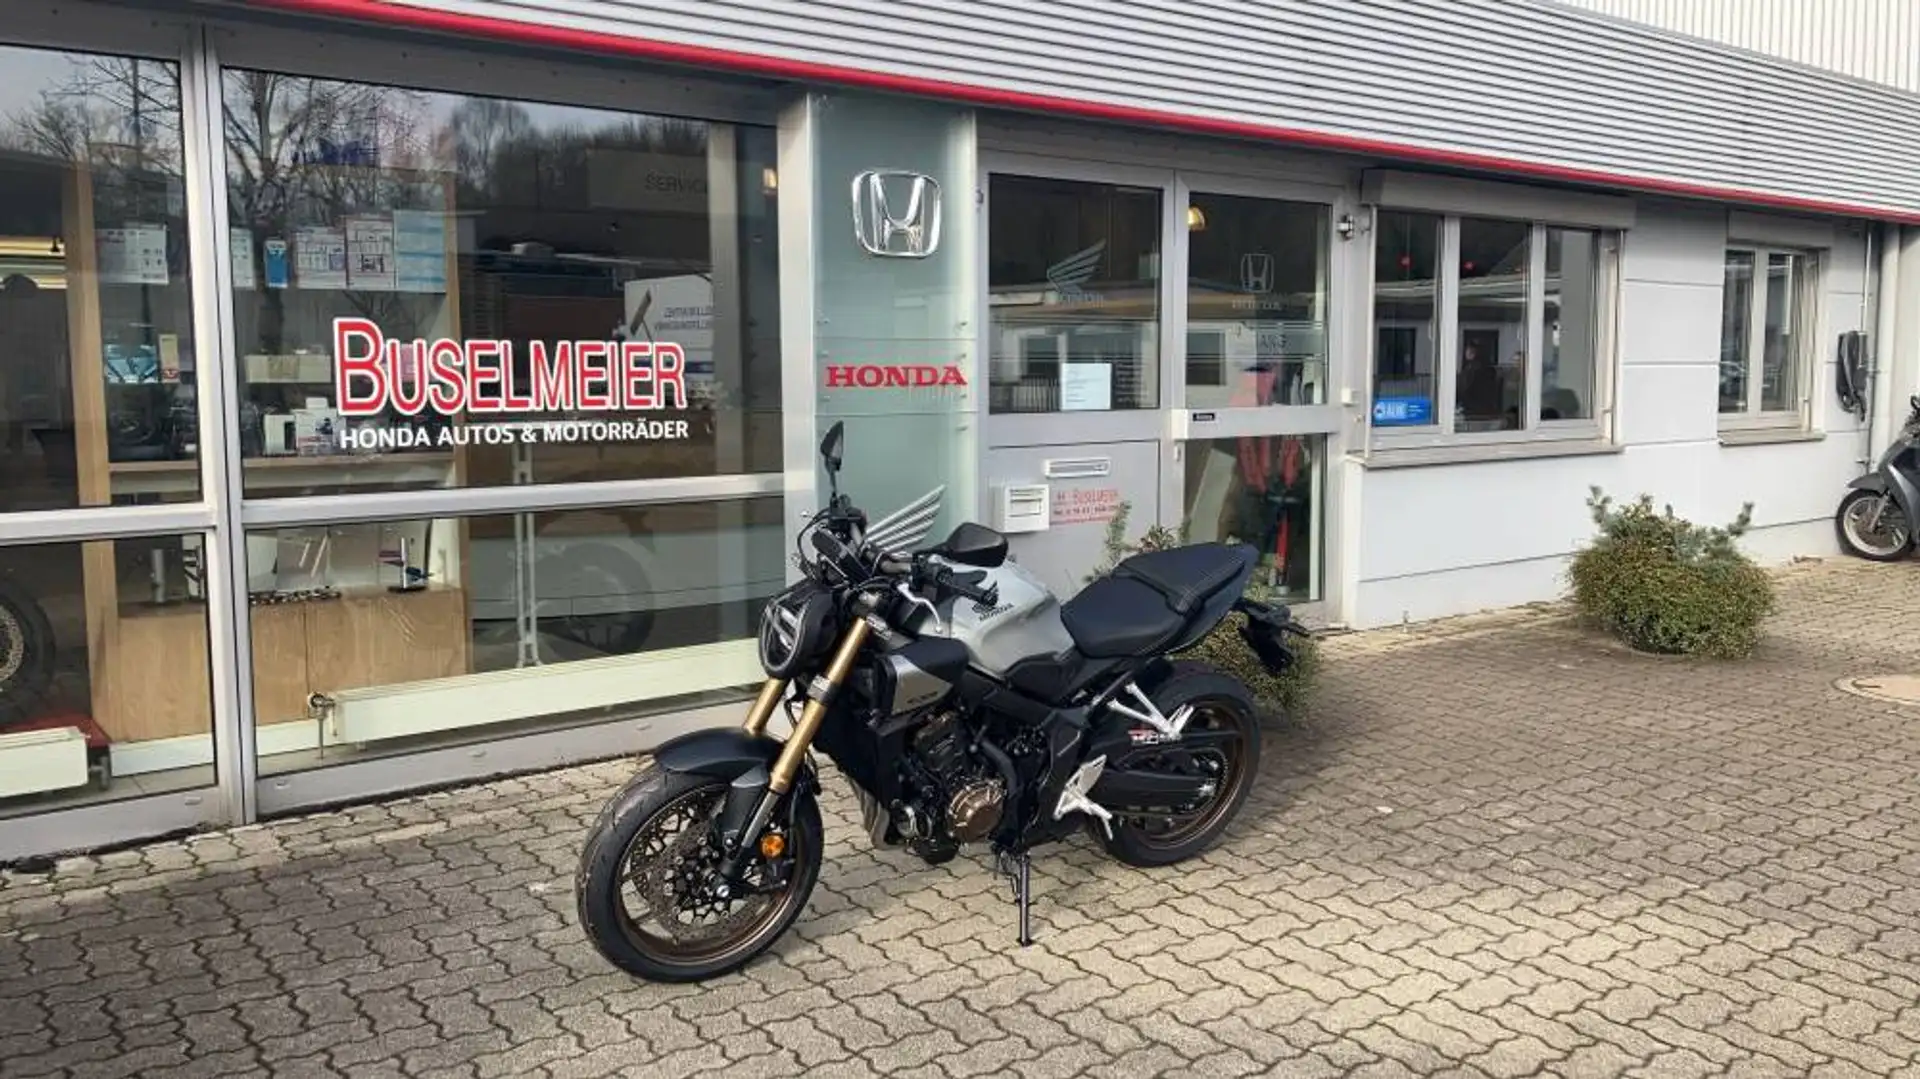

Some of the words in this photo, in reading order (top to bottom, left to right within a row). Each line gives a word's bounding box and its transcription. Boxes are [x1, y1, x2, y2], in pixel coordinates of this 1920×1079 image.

[333, 317, 688, 416] BUSELMEIER
[825, 365, 968, 388] HONDA
[340, 427, 431, 449] HONDA
[437, 425, 513, 445] AUTOS
[521, 424, 538, 443] &
[543, 418, 689, 443] MOTORRÄDER
